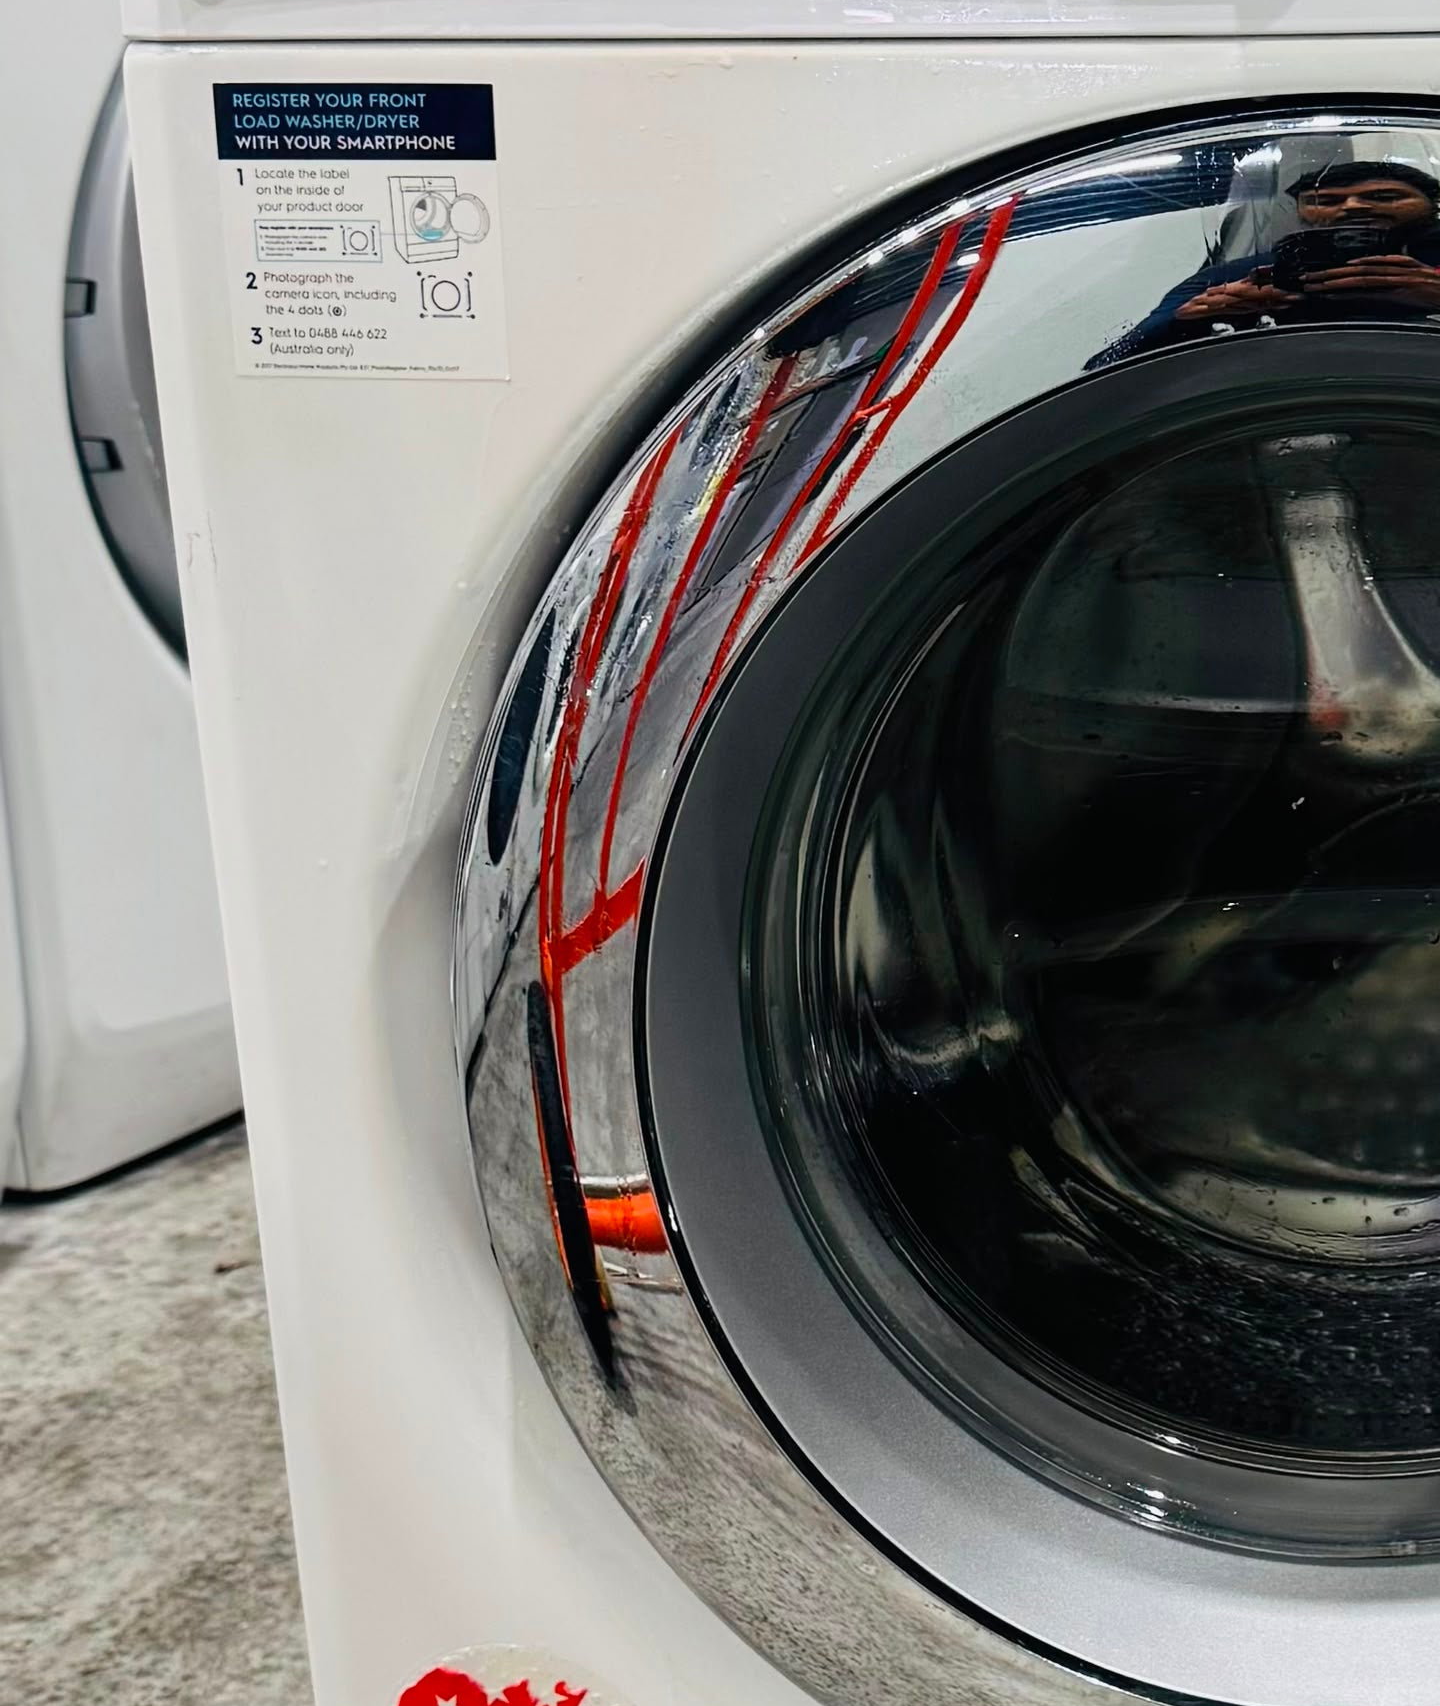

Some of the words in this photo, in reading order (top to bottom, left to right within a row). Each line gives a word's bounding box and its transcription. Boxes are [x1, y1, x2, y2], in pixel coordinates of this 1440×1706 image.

[233, 93, 310, 108] REGISTER
[315, 93, 363, 108] YOUR
[369, 93, 427, 108] FRONT
[234, 114, 280, 129] LOAD
[285, 114, 420, 131] WASHER/DRYER
[235, 135, 279, 150] WITH
[283, 135, 331, 150] YOUR
[337, 135, 456, 150] SMARTPHONE
[236, 168, 244, 186] 1
[255, 168, 295, 179] Locate
[298, 168, 317, 179] the
[320, 168, 350, 179] label
[256, 186, 272, 196] on
[274, 185, 292, 196] the
[297, 185, 330, 196] inside
[333, 185, 345, 196] of
[257, 202, 284, 213] your
[287, 201, 333, 213] product
[336, 201, 364, 212] door
[245, 272, 258, 290] 2
[264, 272, 333, 285] Photograph
[335, 272, 354, 284] the
[265, 290, 310, 300] camera
[344, 289, 397, 303] including
[265, 304, 284, 316] the
[288, 305, 296, 315] 4
[298, 304, 324, 316] dots
[251, 327, 263, 345] 3
[269, 327, 291, 339] Text
[294, 328, 306, 339] to
[309, 328, 338, 340] 0488
[367, 329, 387, 340] 622
[270, 343, 324, 356] (Australia
[326, 343, 354, 357] only)
